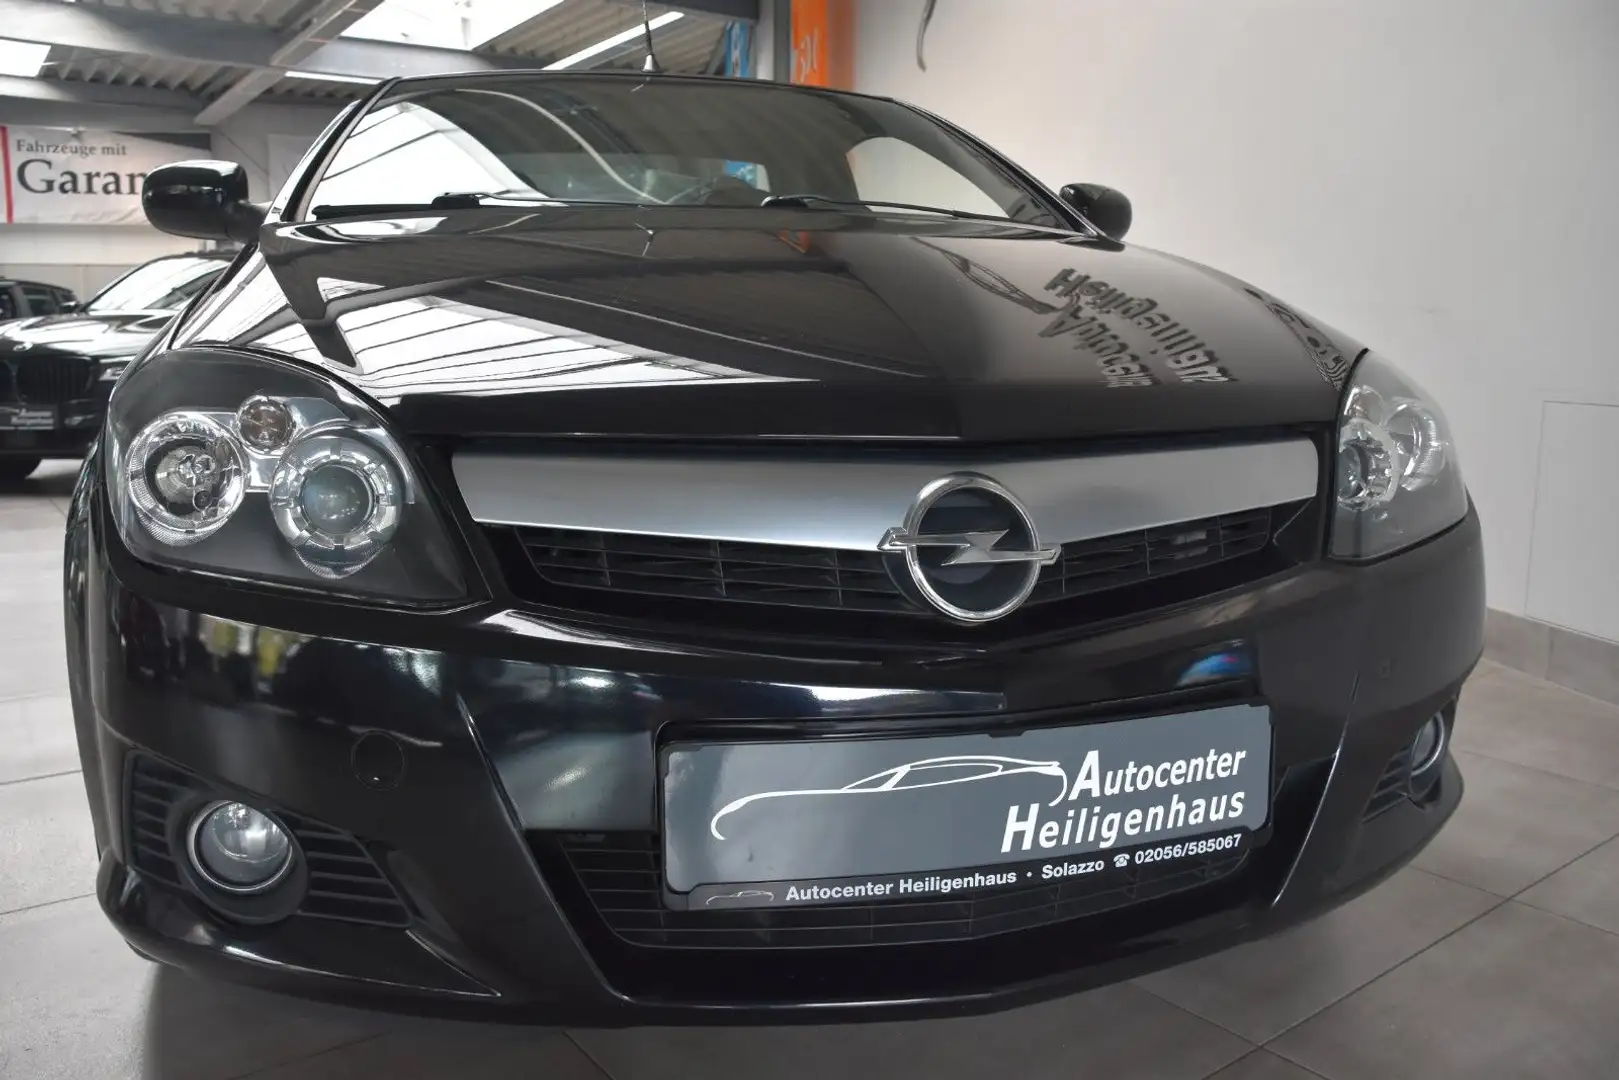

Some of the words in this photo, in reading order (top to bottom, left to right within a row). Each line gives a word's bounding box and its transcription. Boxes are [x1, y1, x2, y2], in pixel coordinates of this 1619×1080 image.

[16, 139, 97, 158] Fahrzeuge
[101, 143, 127, 156] mit
[1067, 749, 1247, 801] Autocenter
[1000, 791, 1246, 853] Heiligenhaus
[786, 882, 893, 901] Autocenter
[899, 872, 1017, 894] Heiligenhaus
[1041, 860, 1105, 880] Solazzo
[1134, 833, 1242, 865] 02056/585067
